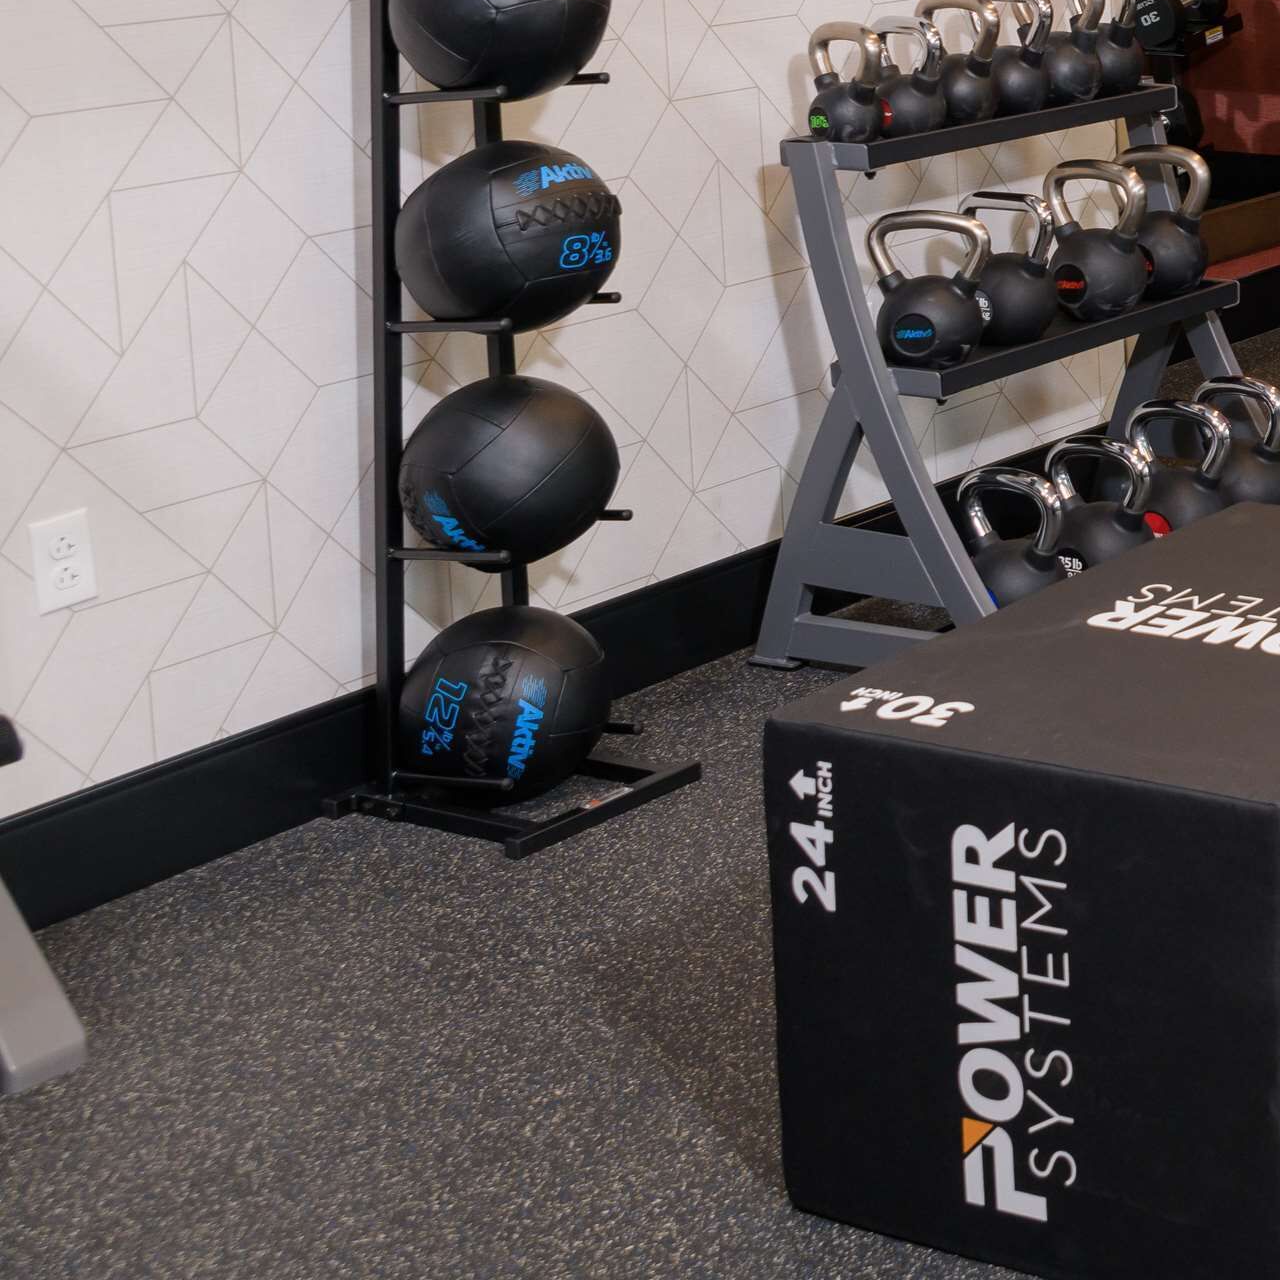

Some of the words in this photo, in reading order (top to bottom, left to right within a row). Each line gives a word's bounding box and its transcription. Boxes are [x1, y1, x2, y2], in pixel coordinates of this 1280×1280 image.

[539, 163, 593, 190] Aktiv
[559, 234, 591, 269] 8
[424, 678, 468, 731] 12
[850, 686, 904, 701] INCH
[876, 695, 976, 728] 30
[507, 698, 544, 770] Aktiv
[789, 820, 836, 913] 24
[816, 760, 834, 818] INCH
[949, 821, 1048, 1222] POWER
[1018, 827, 1076, 1185] SYSTEMS
